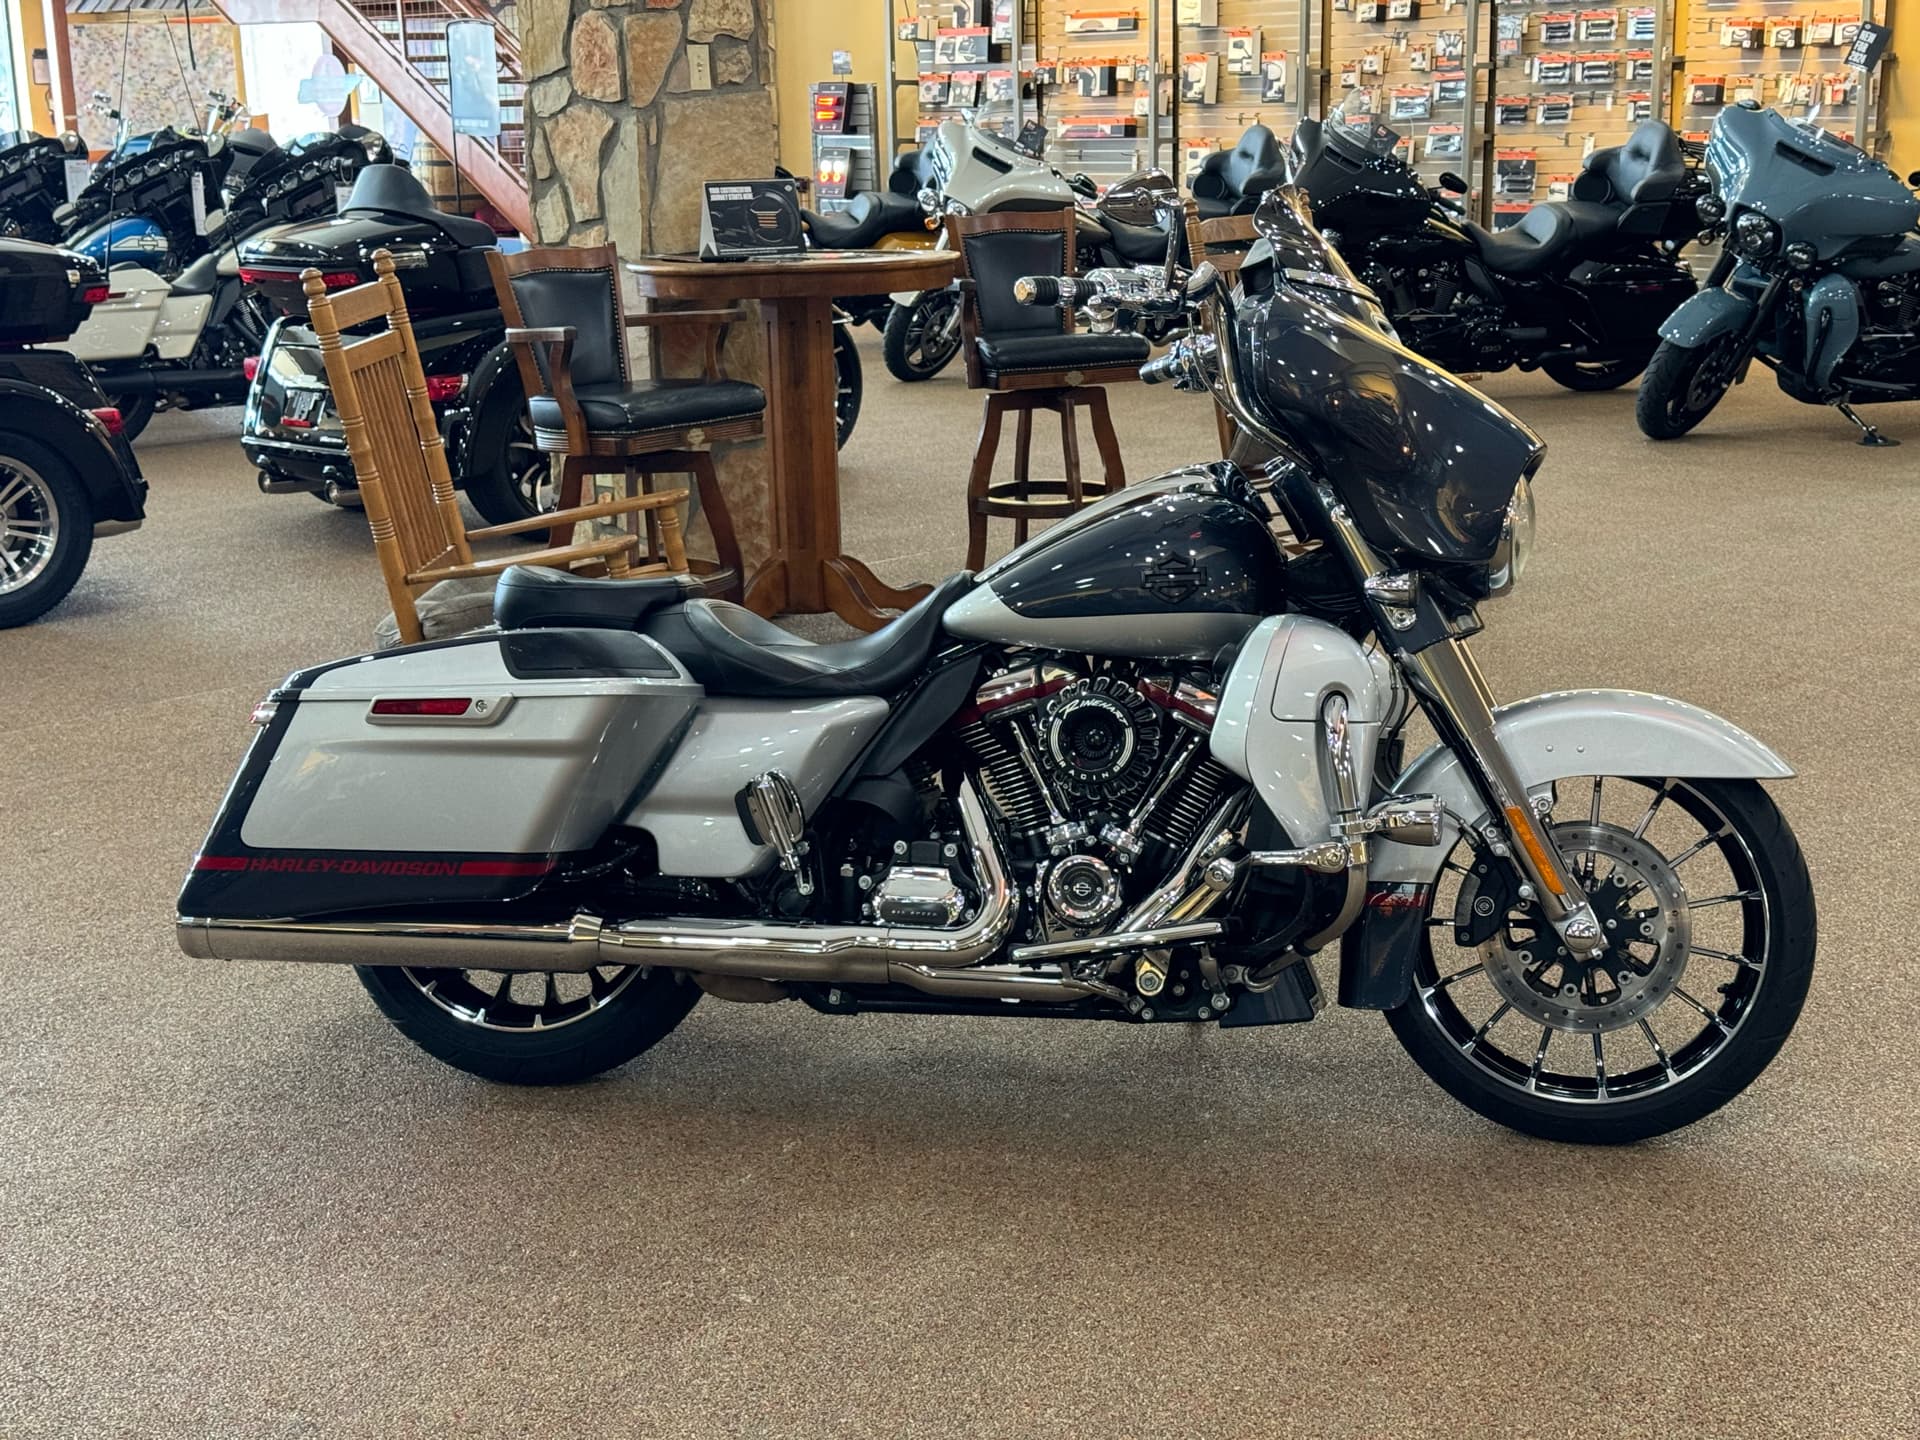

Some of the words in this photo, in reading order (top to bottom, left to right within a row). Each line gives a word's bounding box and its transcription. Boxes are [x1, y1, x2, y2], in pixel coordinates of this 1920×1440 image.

[1859, 30, 1877, 44] NEW
[1853, 40, 1869, 53] FOR
[1848, 50, 1868, 64] 2024
[1058, 699, 1128, 726] RINEHART
[249, 857, 458, 876] HARLEY-DAVIDSON
